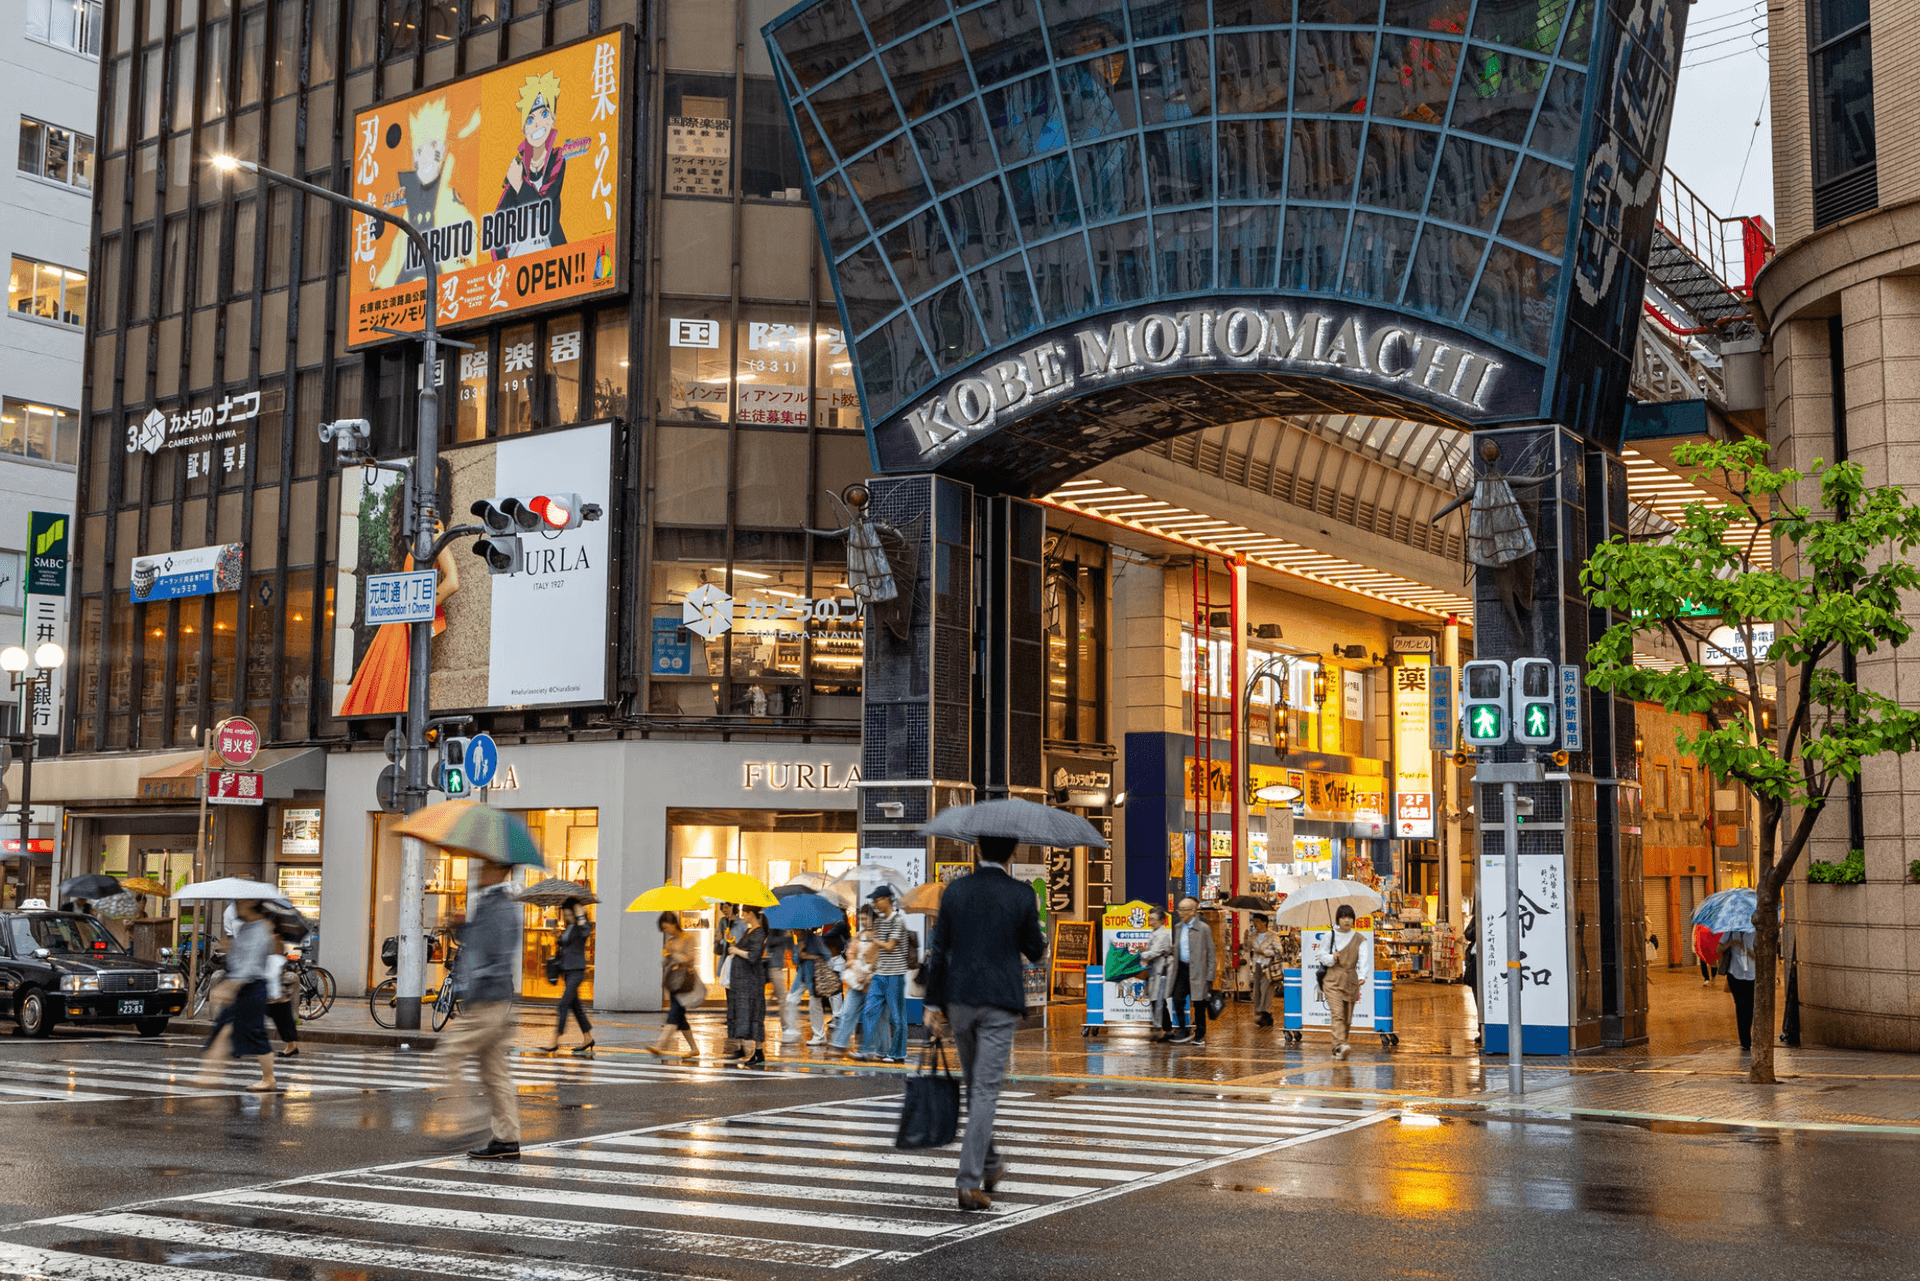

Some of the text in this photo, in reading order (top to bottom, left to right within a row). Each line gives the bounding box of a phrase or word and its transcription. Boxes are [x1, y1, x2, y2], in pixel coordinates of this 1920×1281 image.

[590, 42, 617, 221] 集え、
[672, 156, 728, 167] ヴァイオリン
[482, 199, 551, 251] BORUTO
[516, 252, 586, 297] OPEN!!
[749, 359, 797, 374] (331)
[903, 306, 1505, 456] KOBE MOTOMACHI
[34, 557, 65, 569] SMBC
[509, 545, 590, 578] URLA
[533, 580, 565, 590] ITALY 1927
[370, 603, 407, 617] Motomachidori
[412, 602, 430, 614] Chome
[33, 602, 56, 726] 三井友銀行
[1398, 667, 1426, 691] 薬
[1564, 670, 1578, 746] 斜め横断専用
[222, 738, 253, 753] 消火栓
[743, 763, 862, 790] FURLA
[1405, 795, 1425, 806] 2F
[1051, 846, 1071, 911] カメラ
[1104, 915, 1127, 927] STOP
[123, 1005, 144, 1014] 23-83
